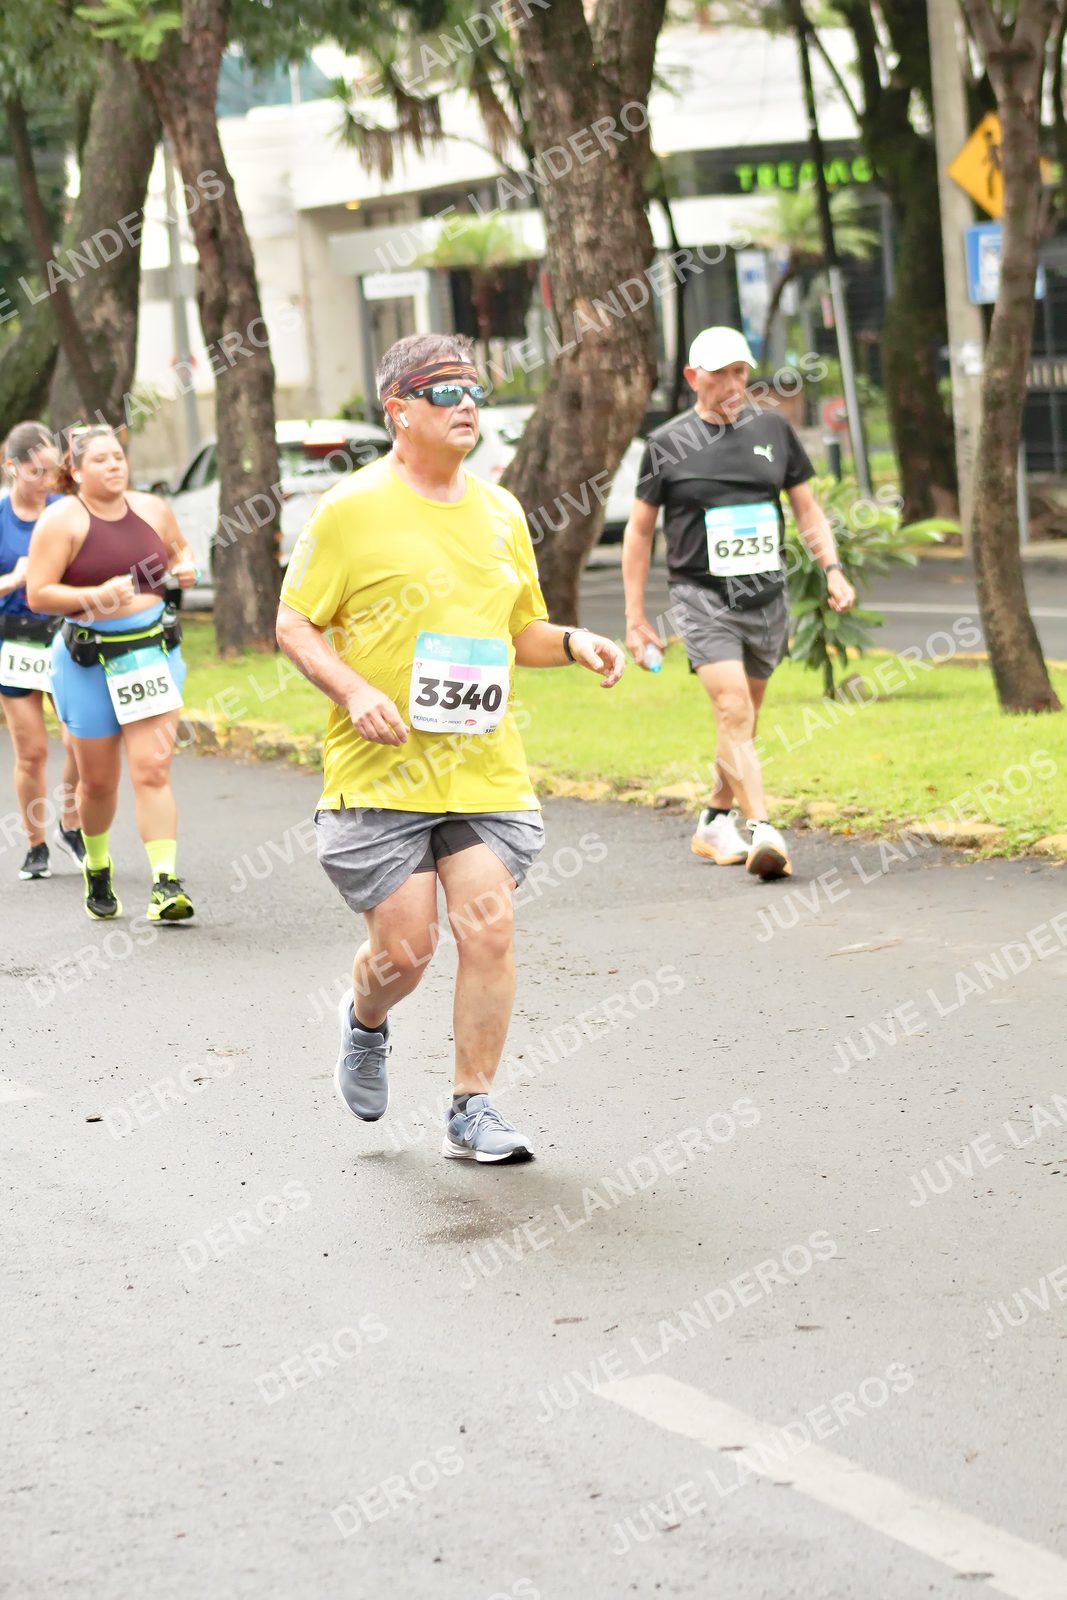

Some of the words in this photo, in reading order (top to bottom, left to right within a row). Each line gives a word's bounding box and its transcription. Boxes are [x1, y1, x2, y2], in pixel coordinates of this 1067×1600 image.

[714, 535, 774, 558] 6235
[8, 654, 52, 675] 150
[117, 676, 169, 704] 5985
[415, 677, 502, 712] 3340
